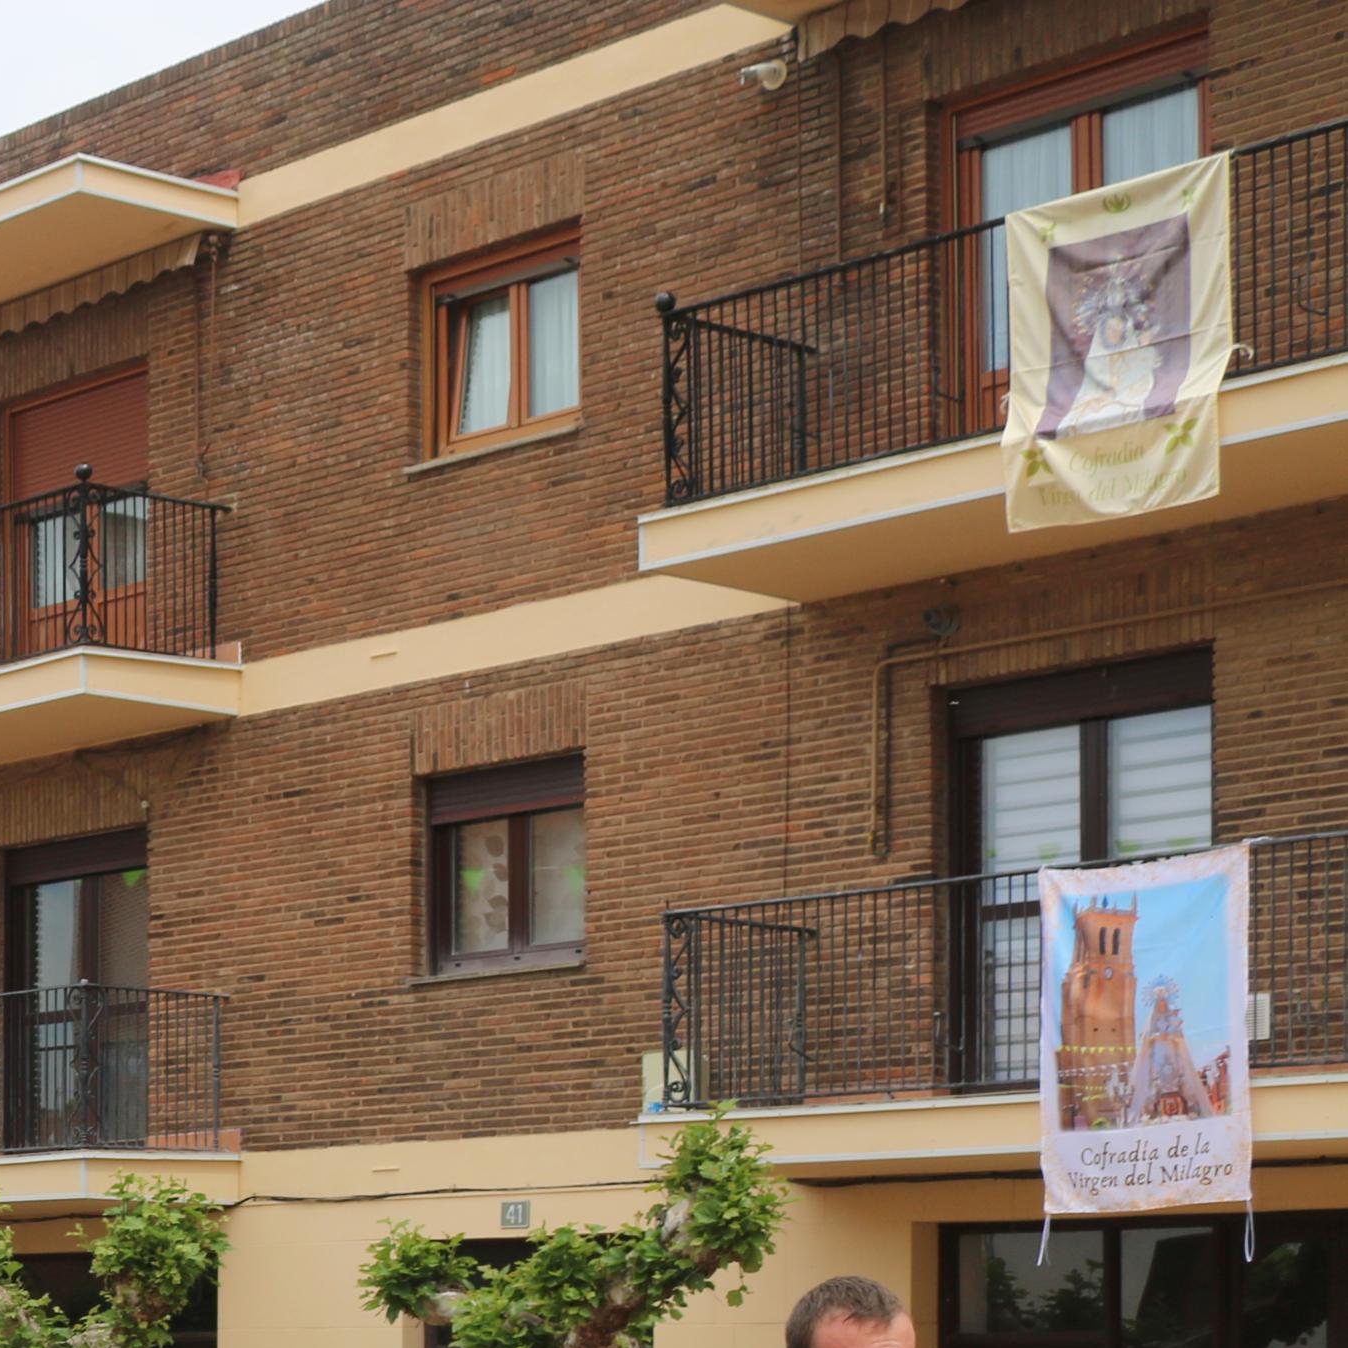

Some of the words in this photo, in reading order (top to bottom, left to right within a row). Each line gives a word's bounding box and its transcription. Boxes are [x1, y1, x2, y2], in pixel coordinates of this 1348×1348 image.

[1089, 480, 1115, 502] del
[1167, 1134, 1189, 1158] de
[1194, 1132, 1210, 1155] la
[1067, 1171, 1119, 1195] Virgen
[1125, 1162, 1152, 1186] del
[1160, 1158, 1234, 1186] Milagro
[505, 1204, 523, 1224] 41
